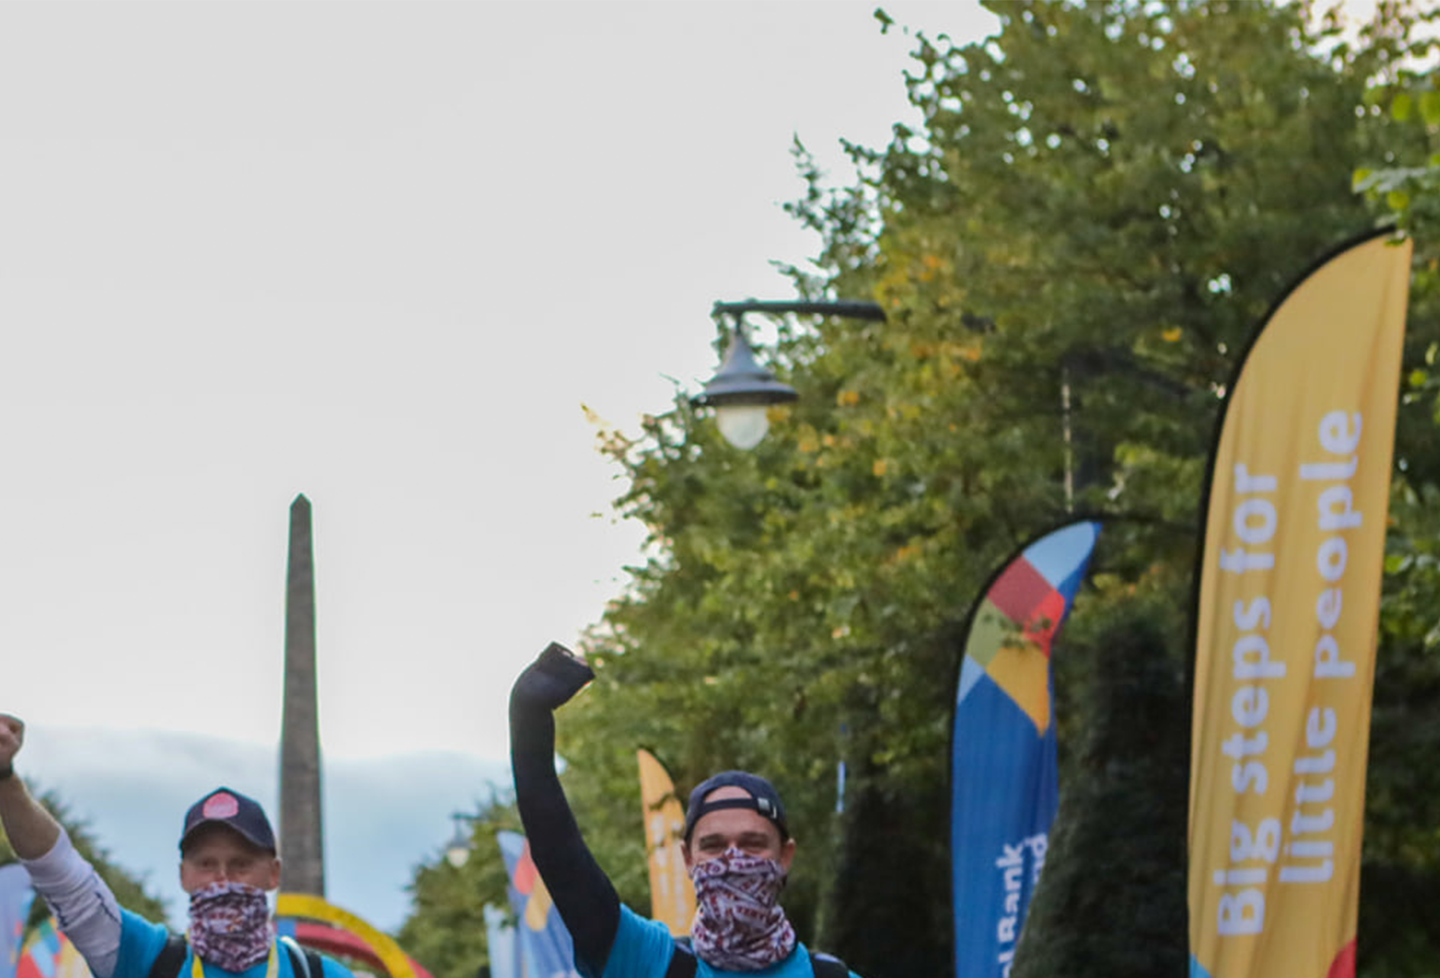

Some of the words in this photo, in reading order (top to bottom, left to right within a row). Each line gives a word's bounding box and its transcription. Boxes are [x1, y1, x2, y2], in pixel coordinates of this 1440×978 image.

[1218, 463, 1279, 573] for
[1298, 409, 1364, 678] people
[1221, 595, 1287, 795] steps
[1213, 817, 1282, 936] Big
[1279, 706, 1338, 884] little
